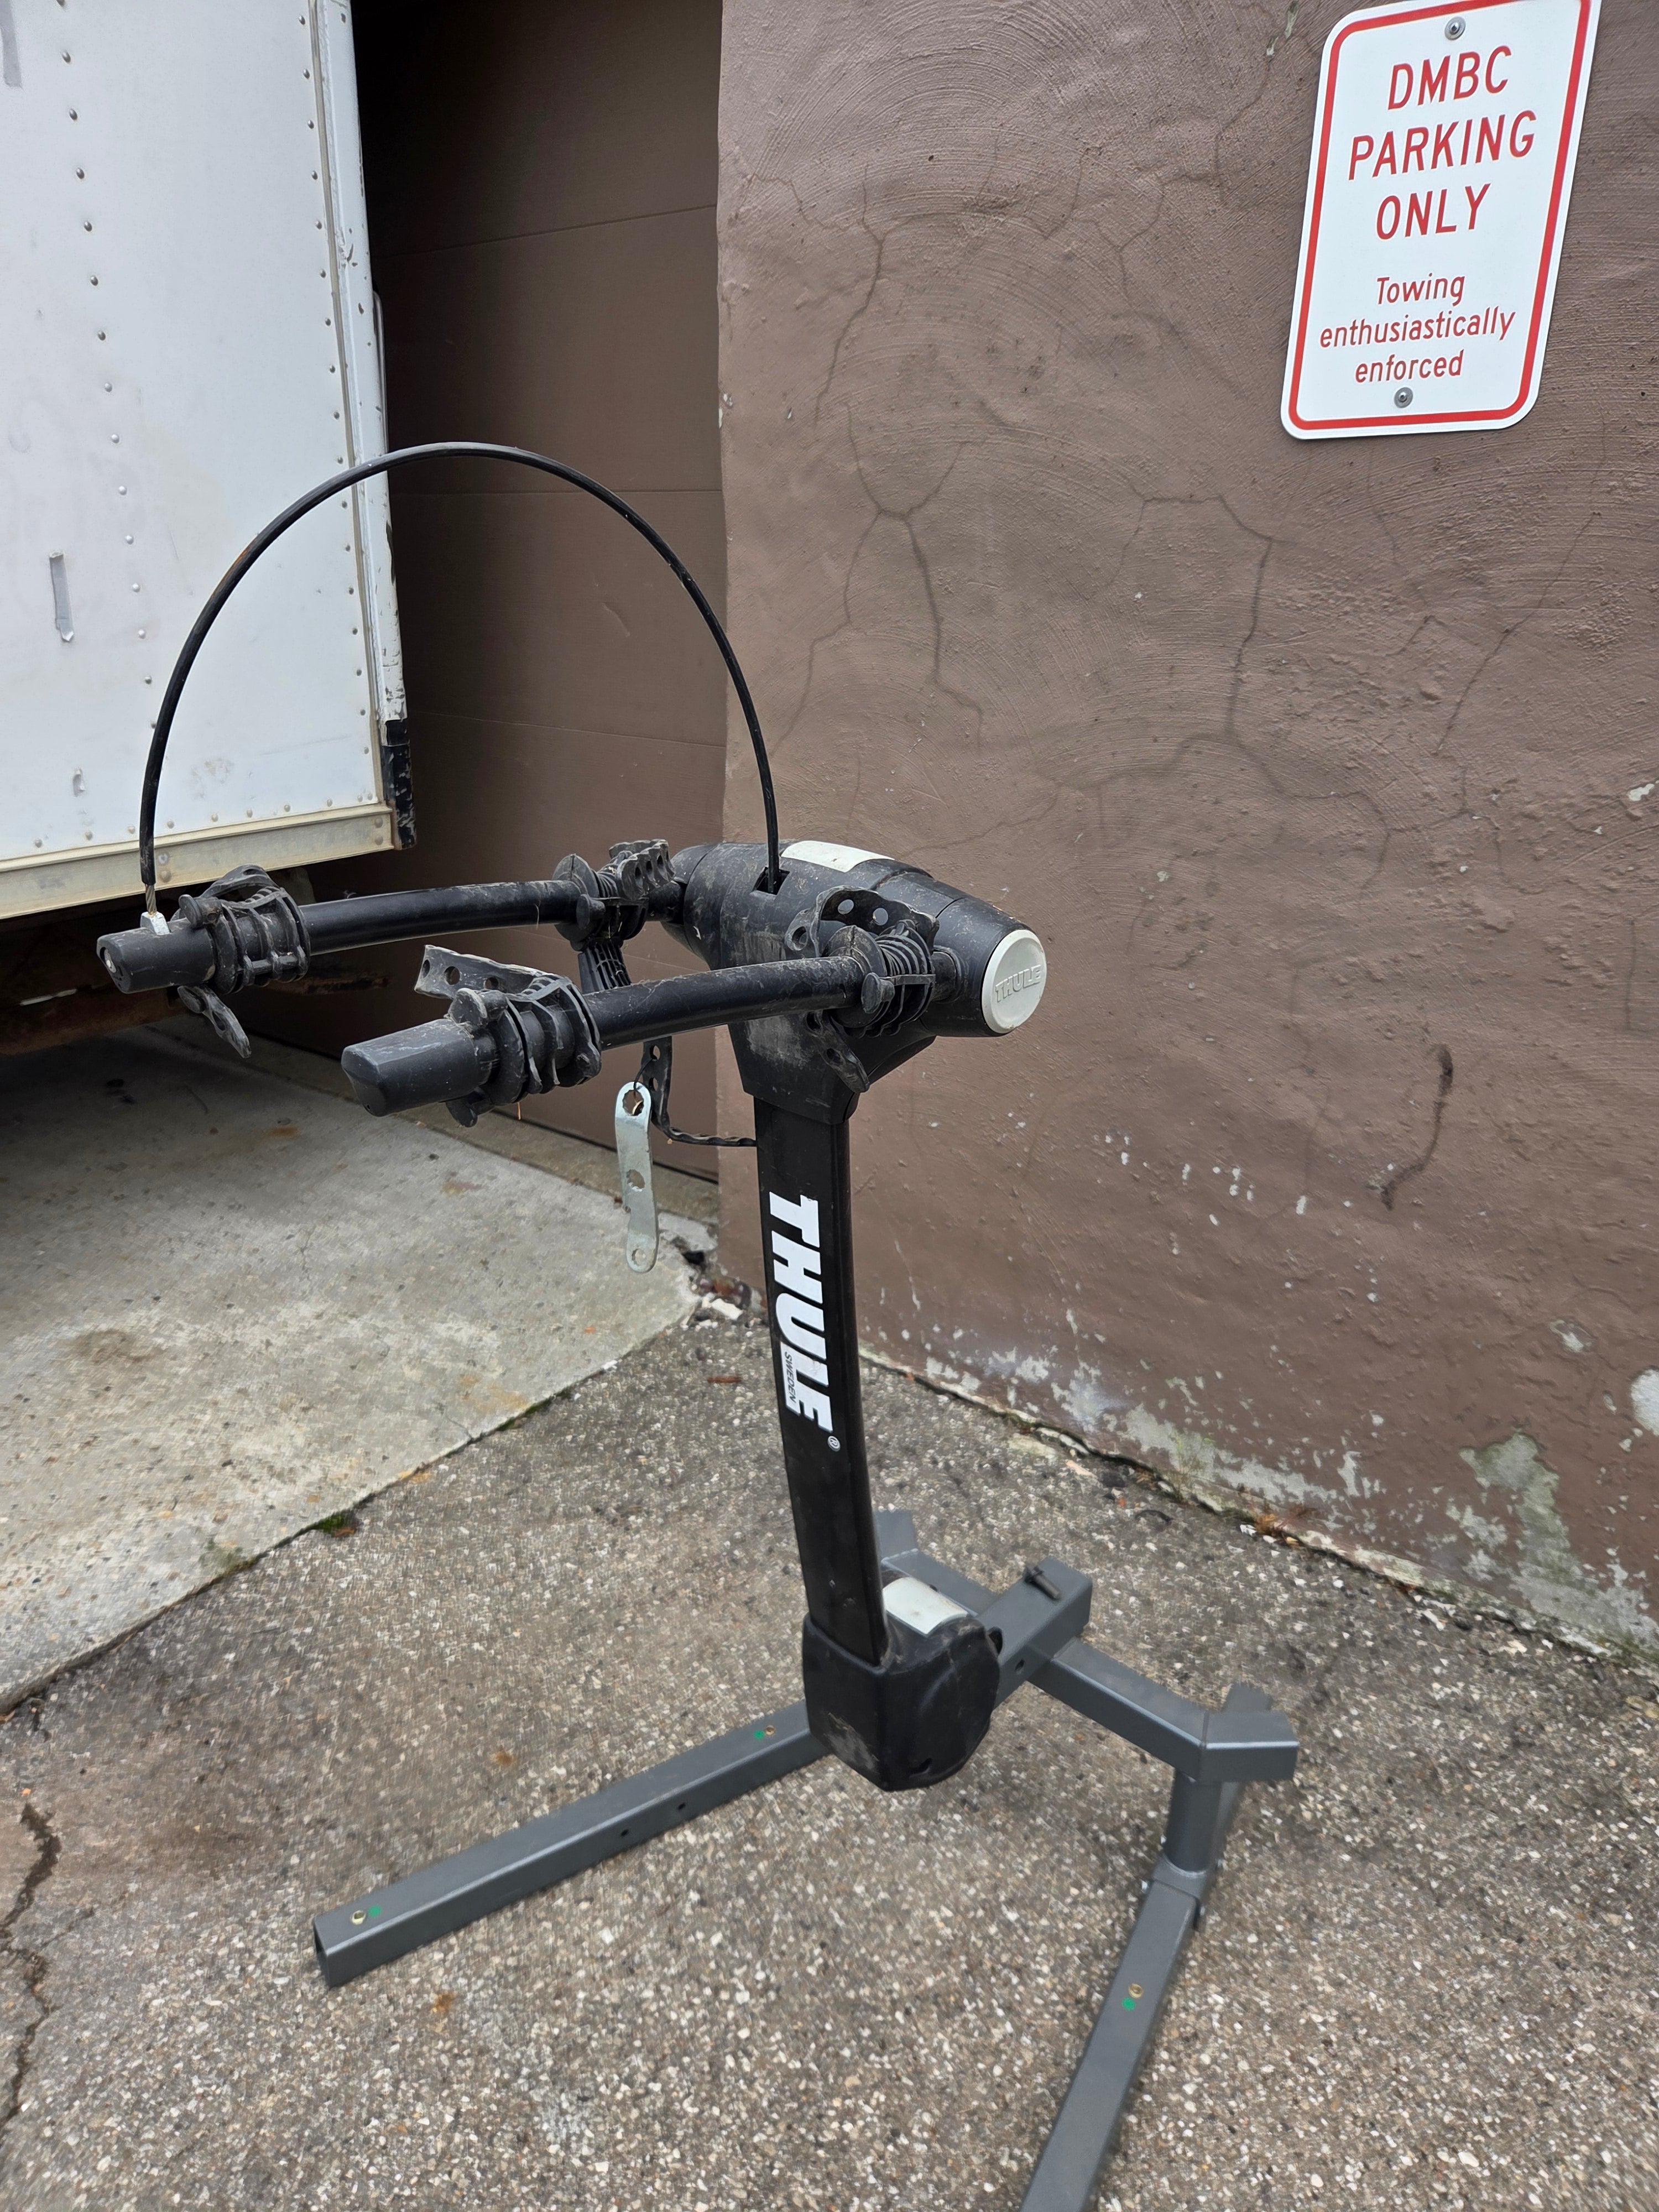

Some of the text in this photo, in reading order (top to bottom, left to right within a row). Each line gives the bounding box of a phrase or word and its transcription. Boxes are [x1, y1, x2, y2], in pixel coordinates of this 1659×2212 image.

[1387, 45, 1512, 110] DMBC
[1348, 110, 1537, 180] PARKING
[1375, 183, 1490, 240] ONLY
[1376, 273, 1465, 306] Towing
[1320, 306, 1516, 348] enthusiastically
[1355, 349, 1464, 383] enforced
[995, 964, 1041, 1003] THULE
[769, 1191, 833, 1432] THULE
[784, 1351, 797, 1404] SWEDEN
